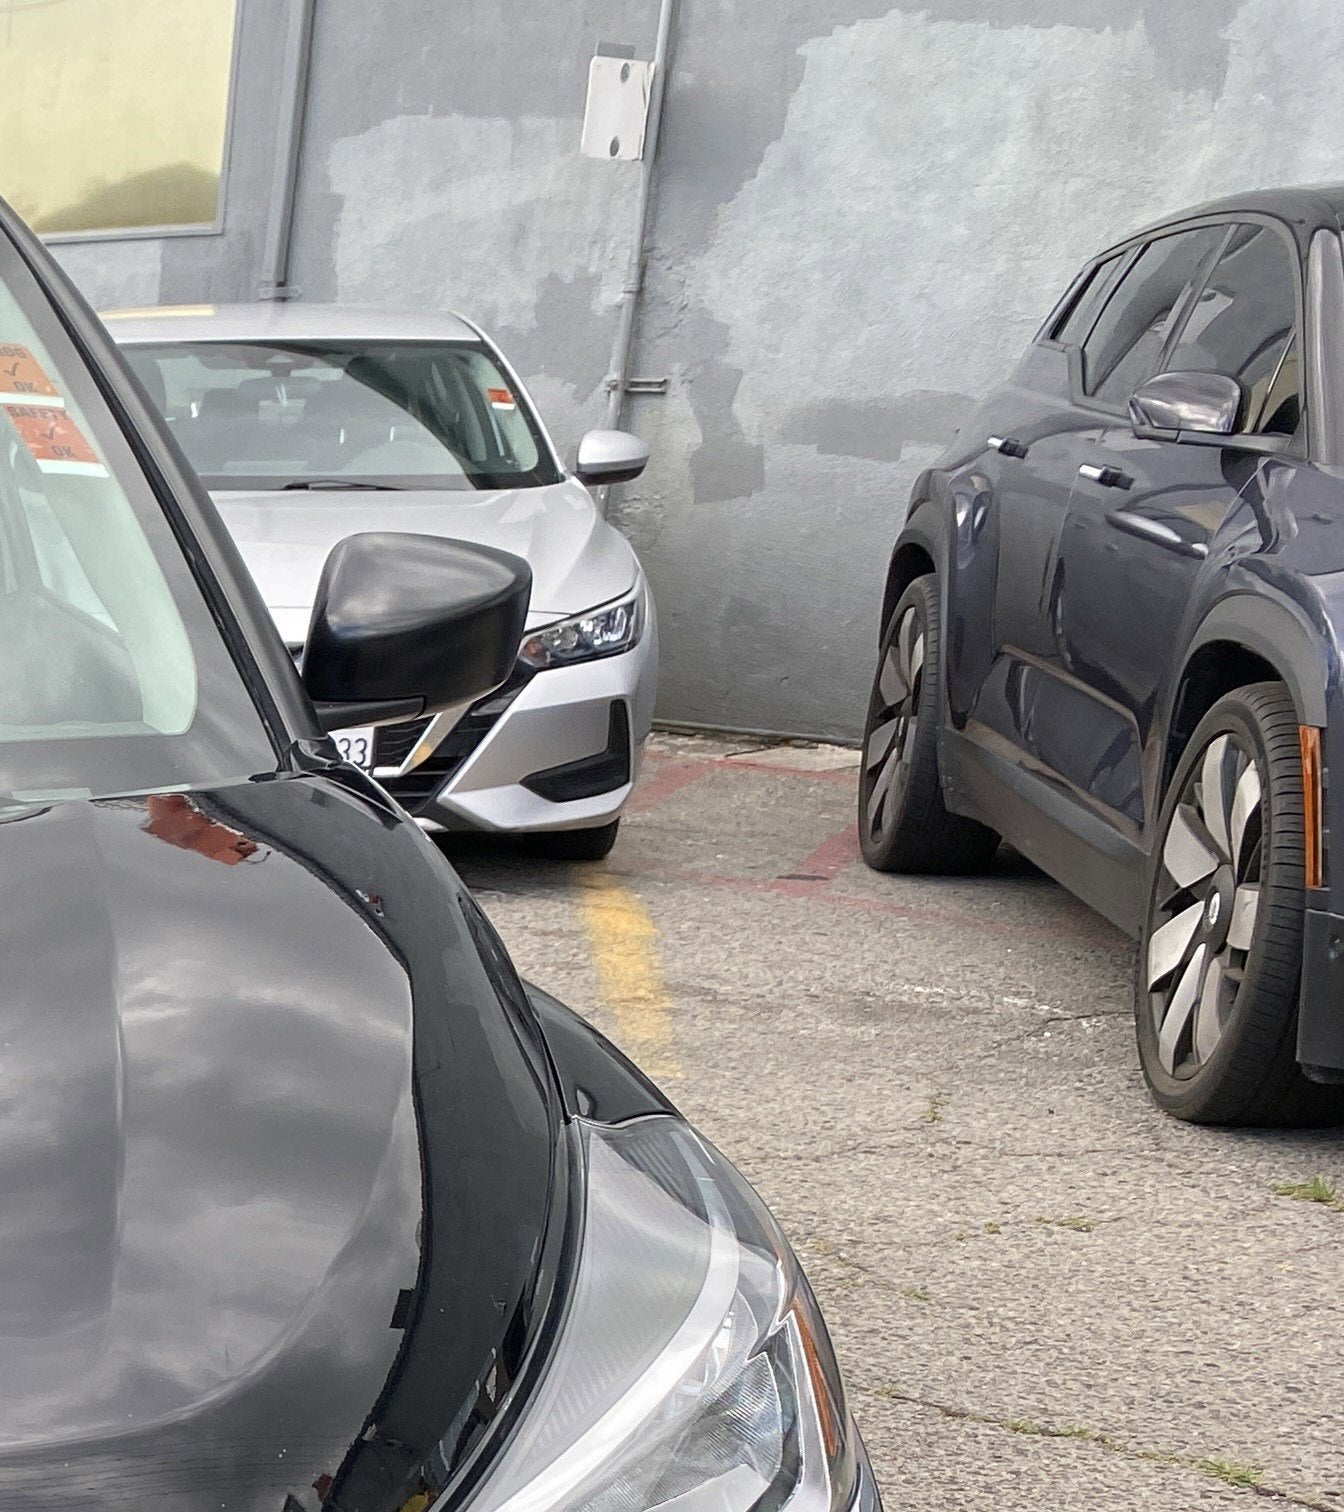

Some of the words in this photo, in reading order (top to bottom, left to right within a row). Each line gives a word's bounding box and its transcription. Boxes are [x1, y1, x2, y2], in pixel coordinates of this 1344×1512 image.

[13, 380, 38, 393] OK
[6, 405, 69, 420] SAFETY
[51, 445, 77, 458] OK
